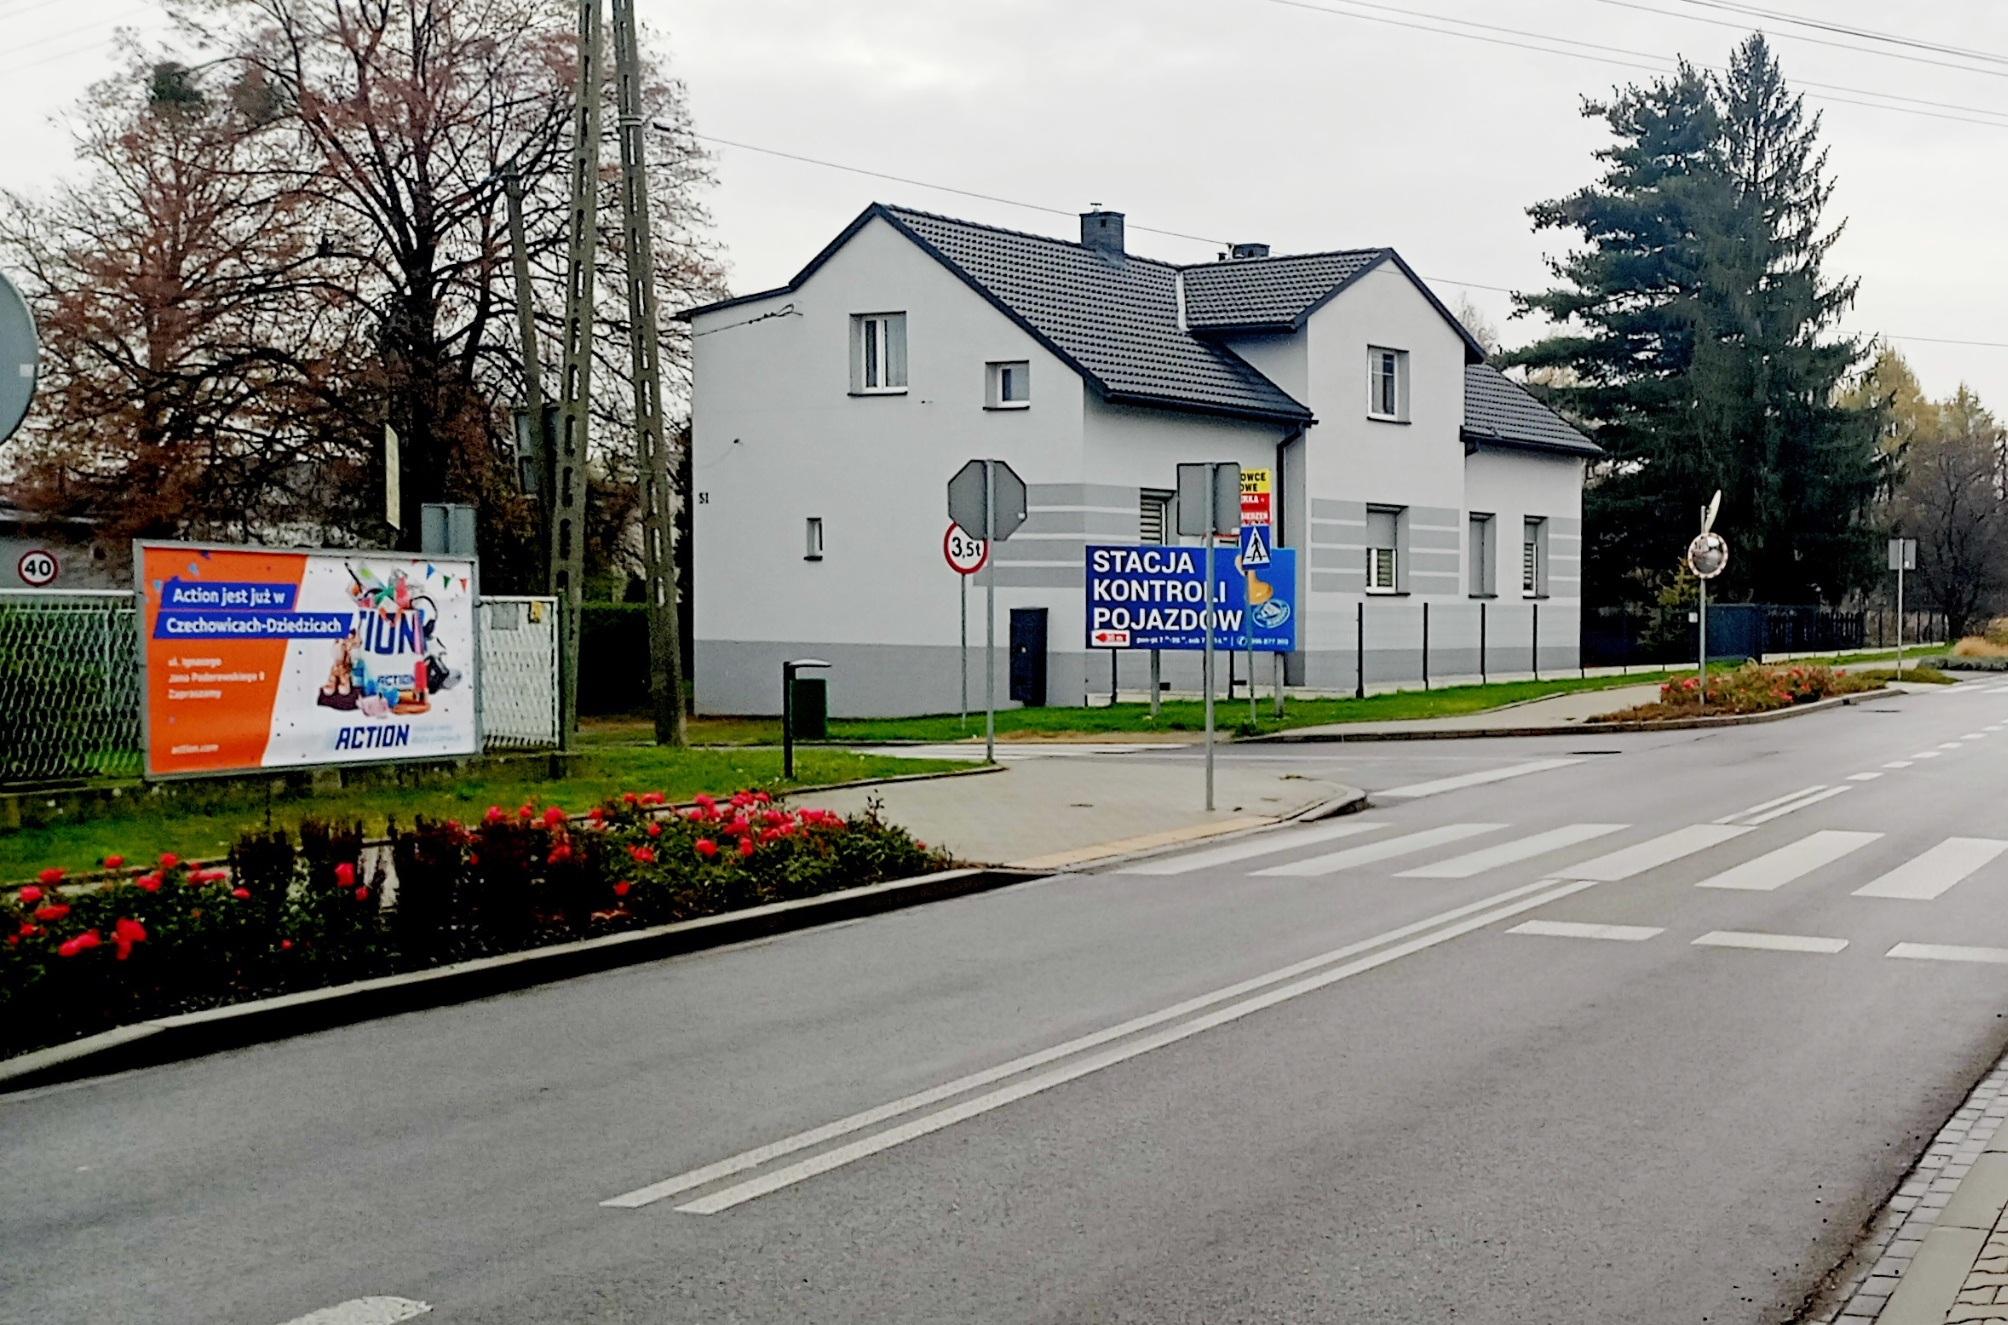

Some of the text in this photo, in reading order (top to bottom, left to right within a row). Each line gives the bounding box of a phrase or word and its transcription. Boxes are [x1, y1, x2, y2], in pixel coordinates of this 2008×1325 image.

[24, 559, 51, 576] 40
[1092, 550, 1195, 574] STACJA
[173, 586, 286, 607] Action jest już w
[1093, 578, 1226, 603] KONTROLI
[166, 616, 342, 633] Czechowicach-Dziedzicach
[335, 724, 410, 750] ACTION
